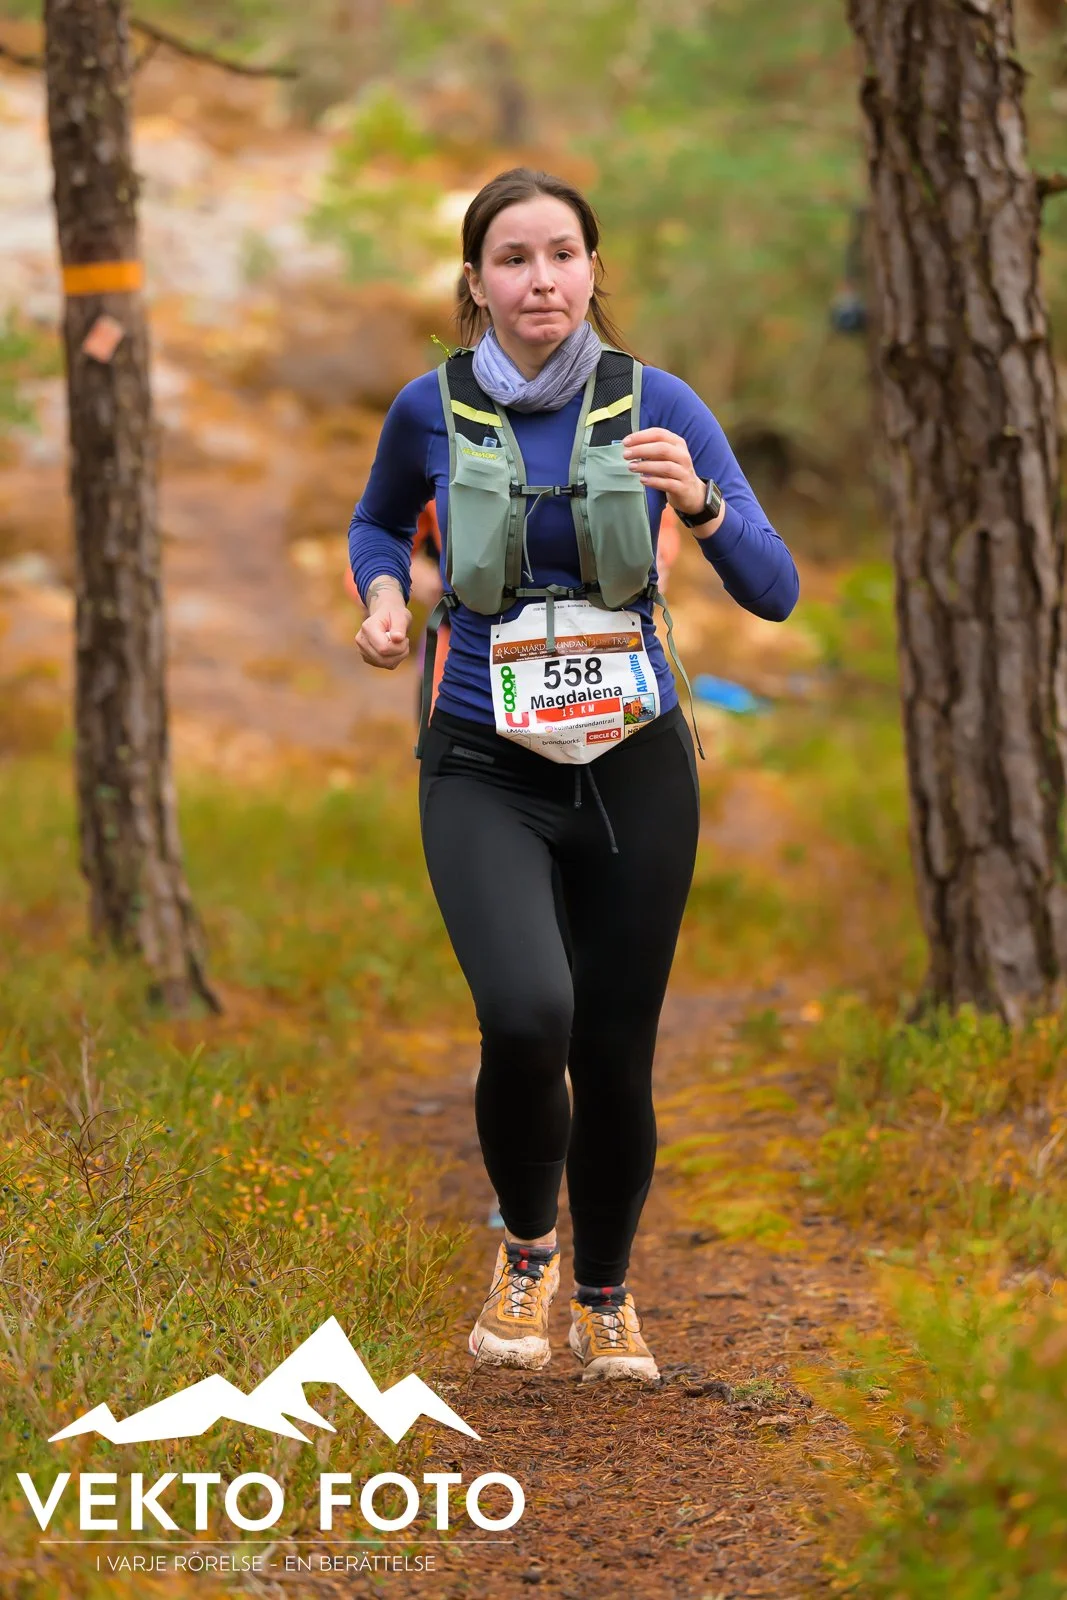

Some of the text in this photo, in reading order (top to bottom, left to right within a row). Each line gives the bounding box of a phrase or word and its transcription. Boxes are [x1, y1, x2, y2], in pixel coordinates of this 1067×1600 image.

[543, 656, 603, 690] 558
[629, 653, 648, 692] Aktivitus
[500, 665, 515, 712] coop
[530, 685, 623, 710] Magdalena
[562, 706, 595, 718] 15 KM
[589, 733, 609, 741] CIRCLE
